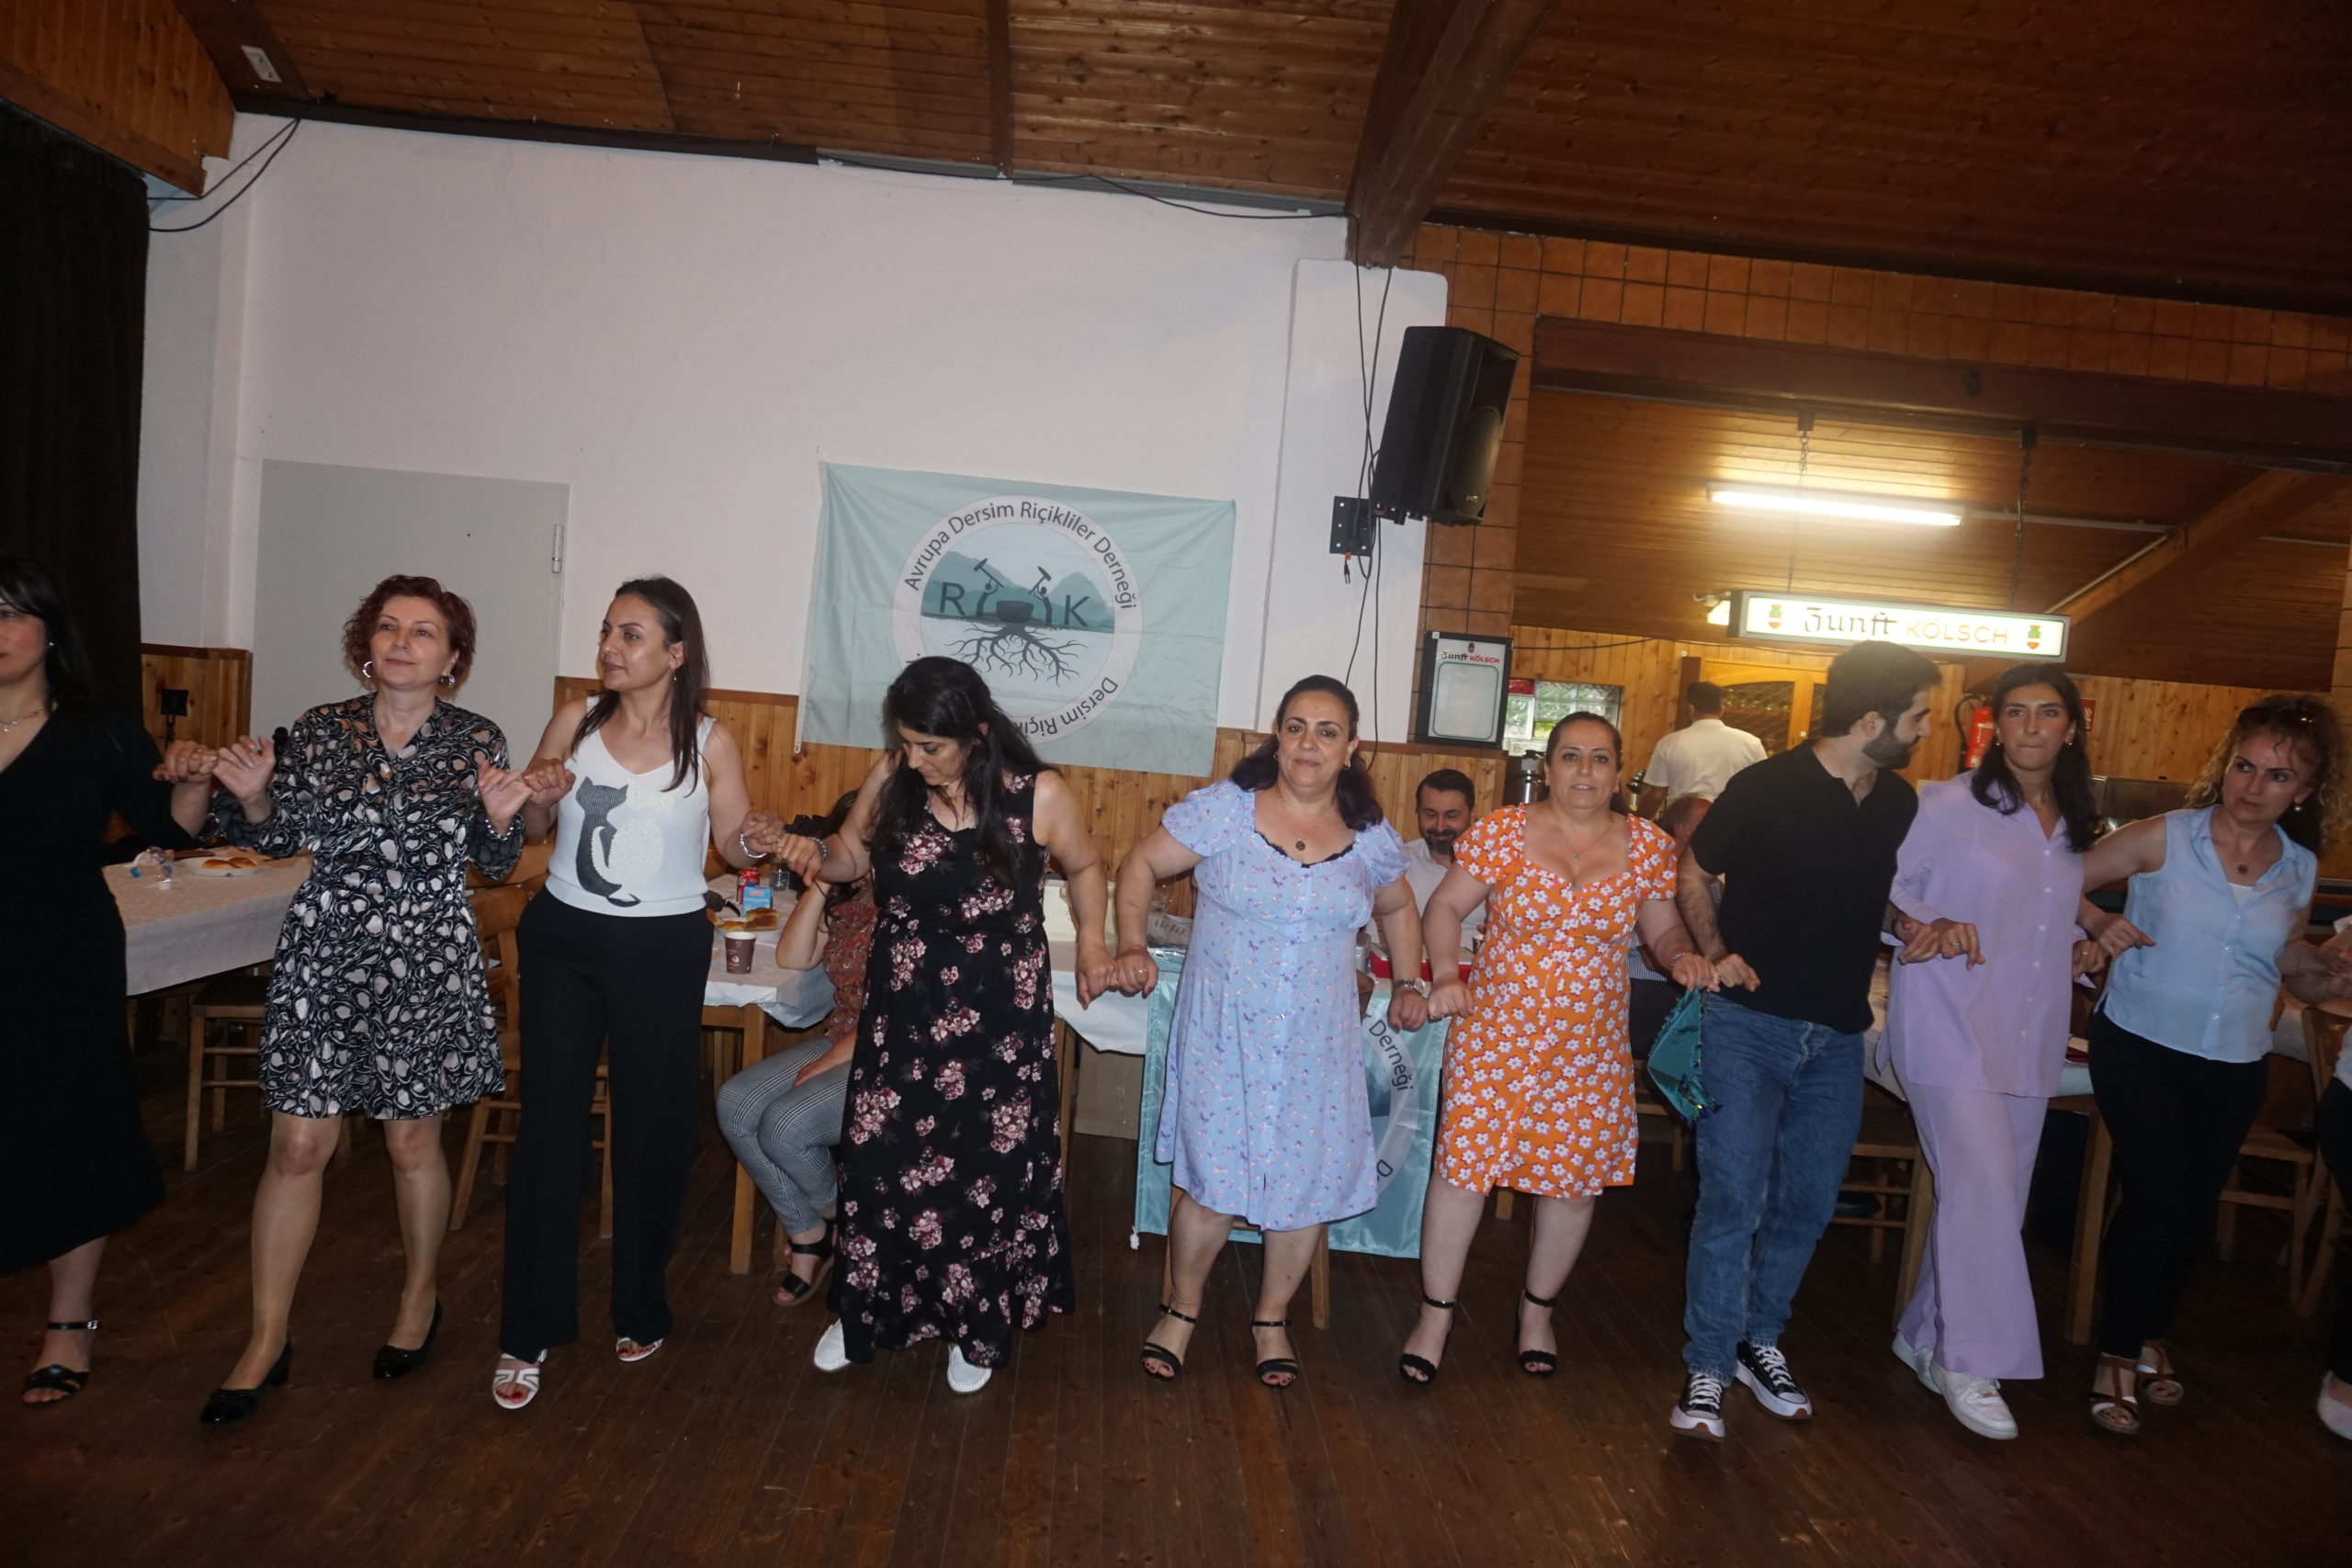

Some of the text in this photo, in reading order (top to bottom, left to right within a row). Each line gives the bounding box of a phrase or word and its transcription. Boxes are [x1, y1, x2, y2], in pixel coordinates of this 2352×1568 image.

[904, 502, 1137, 609] Avrupa Dersim Riçikliler Derneği
[1060, 677, 1118, 719] Dersim
[1369, 1020, 1414, 1090] Derneği
